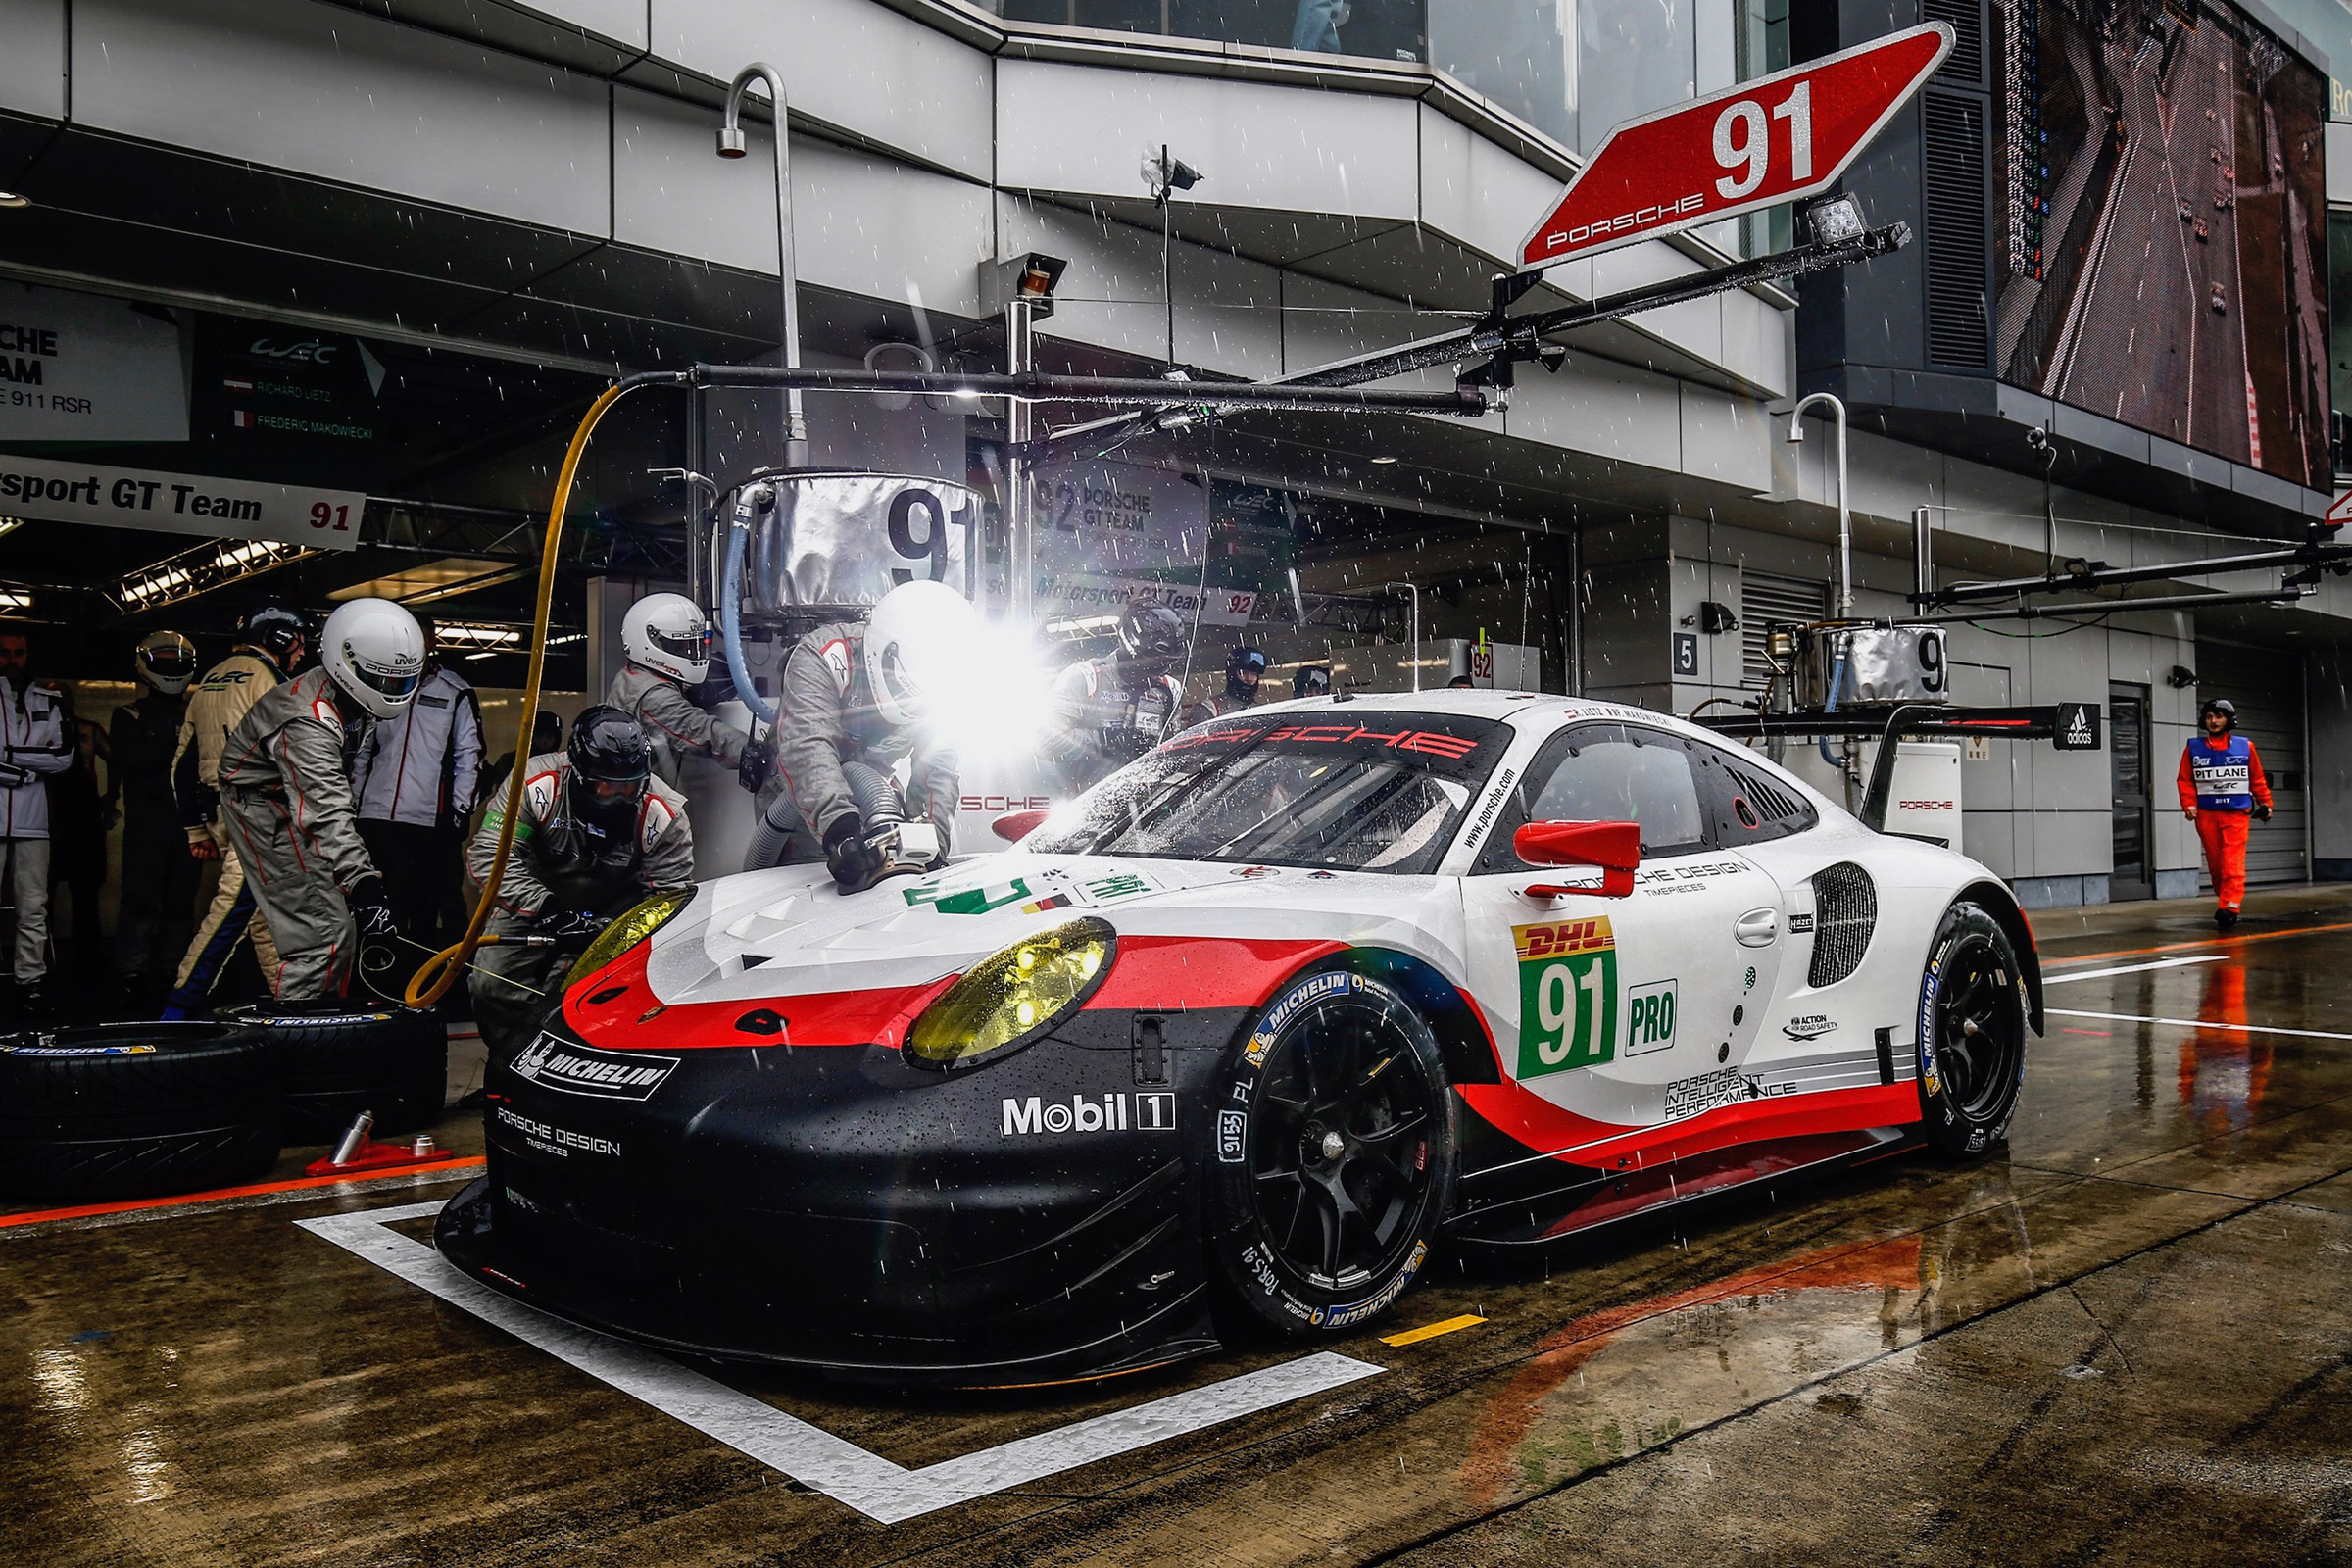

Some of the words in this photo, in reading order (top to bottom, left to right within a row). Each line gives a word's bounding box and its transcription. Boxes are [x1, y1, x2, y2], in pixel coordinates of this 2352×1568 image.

[1712, 80, 1814, 200] 91
[1546, 193, 1705, 250] PORSCHE
[250, 338, 337, 364] WEC
[12, 391, 44, 409] 911
[52, 395, 92, 415] RSR
[257, 381, 303, 399] RICHARD
[305, 386, 331, 403] LIETZ
[257, 415, 309, 432] FREDERIC
[311, 420, 373, 440] MAKOWIECKI
[111, 478, 161, 511] GT
[172, 484, 263, 522] Team
[1034, 478, 1076, 532] 92
[1083, 488, 1150, 513] PORSCHE
[309, 502, 350, 532] 91
[1083, 509, 1101, 527] GT
[1108, 512, 1145, 532] TEAM
[888, 488, 976, 602] 91
[1036, 575, 1130, 606] Motorsport
[1166, 590, 1208, 611] Team
[1229, 594, 1252, 614] 92
[394, 656, 417, 665] uvex
[1473, 652, 1491, 679] 92
[1681, 639, 1692, 670] 5
[334, 671, 355, 692] uvex
[1584, 707, 1604, 716] LIETZ
[1624, 710, 1673, 727] MAKOWIECKI
[2067, 731, 2092, 745] adidas
[2195, 769, 2212, 778] PIT
[2216, 768, 2247, 777] LANE
[959, 796, 1050, 811] SCHE
[1464, 768, 1516, 849] www.porsche.com
[1900, 801, 1953, 810] PORSCHE
[1564, 867, 1673, 890] POCHE
[1674, 860, 1752, 879] DESIGN
[1643, 883, 1707, 898] TIMEPIECES
[1791, 918, 1813, 929] HAZET
[1525, 921, 1604, 956] DHL
[1267, 973, 1346, 1030] MICHELIN
[1538, 957, 1605, 1066] 91
[1628, 991, 1675, 1047] PRO
[1802, 1014, 1827, 1025] ACTION
[1923, 978, 1935, 1058] MICHELIN
[545, 1054, 667, 1086] MICHELIN
[1666, 1066, 1738, 1094] PORSCHE
[1233, 1077, 1254, 1103] FL
[1665, 1074, 1765, 1106] INTELLIGENT
[1665, 1082, 1798, 1119] PERFORMANCE
[1002, 1093, 1128, 1136] Mobil
[498, 1107, 552, 1140] PORSCHE
[556, 1128, 621, 1157] DESIGN
[1223, 1114, 1243, 1152] 9155
[525, 1137, 568, 1158] TIMEPIECES
[1284, 1301, 1311, 1321] MICHELIN
[1328, 1275, 1406, 1327] MICHELIN
